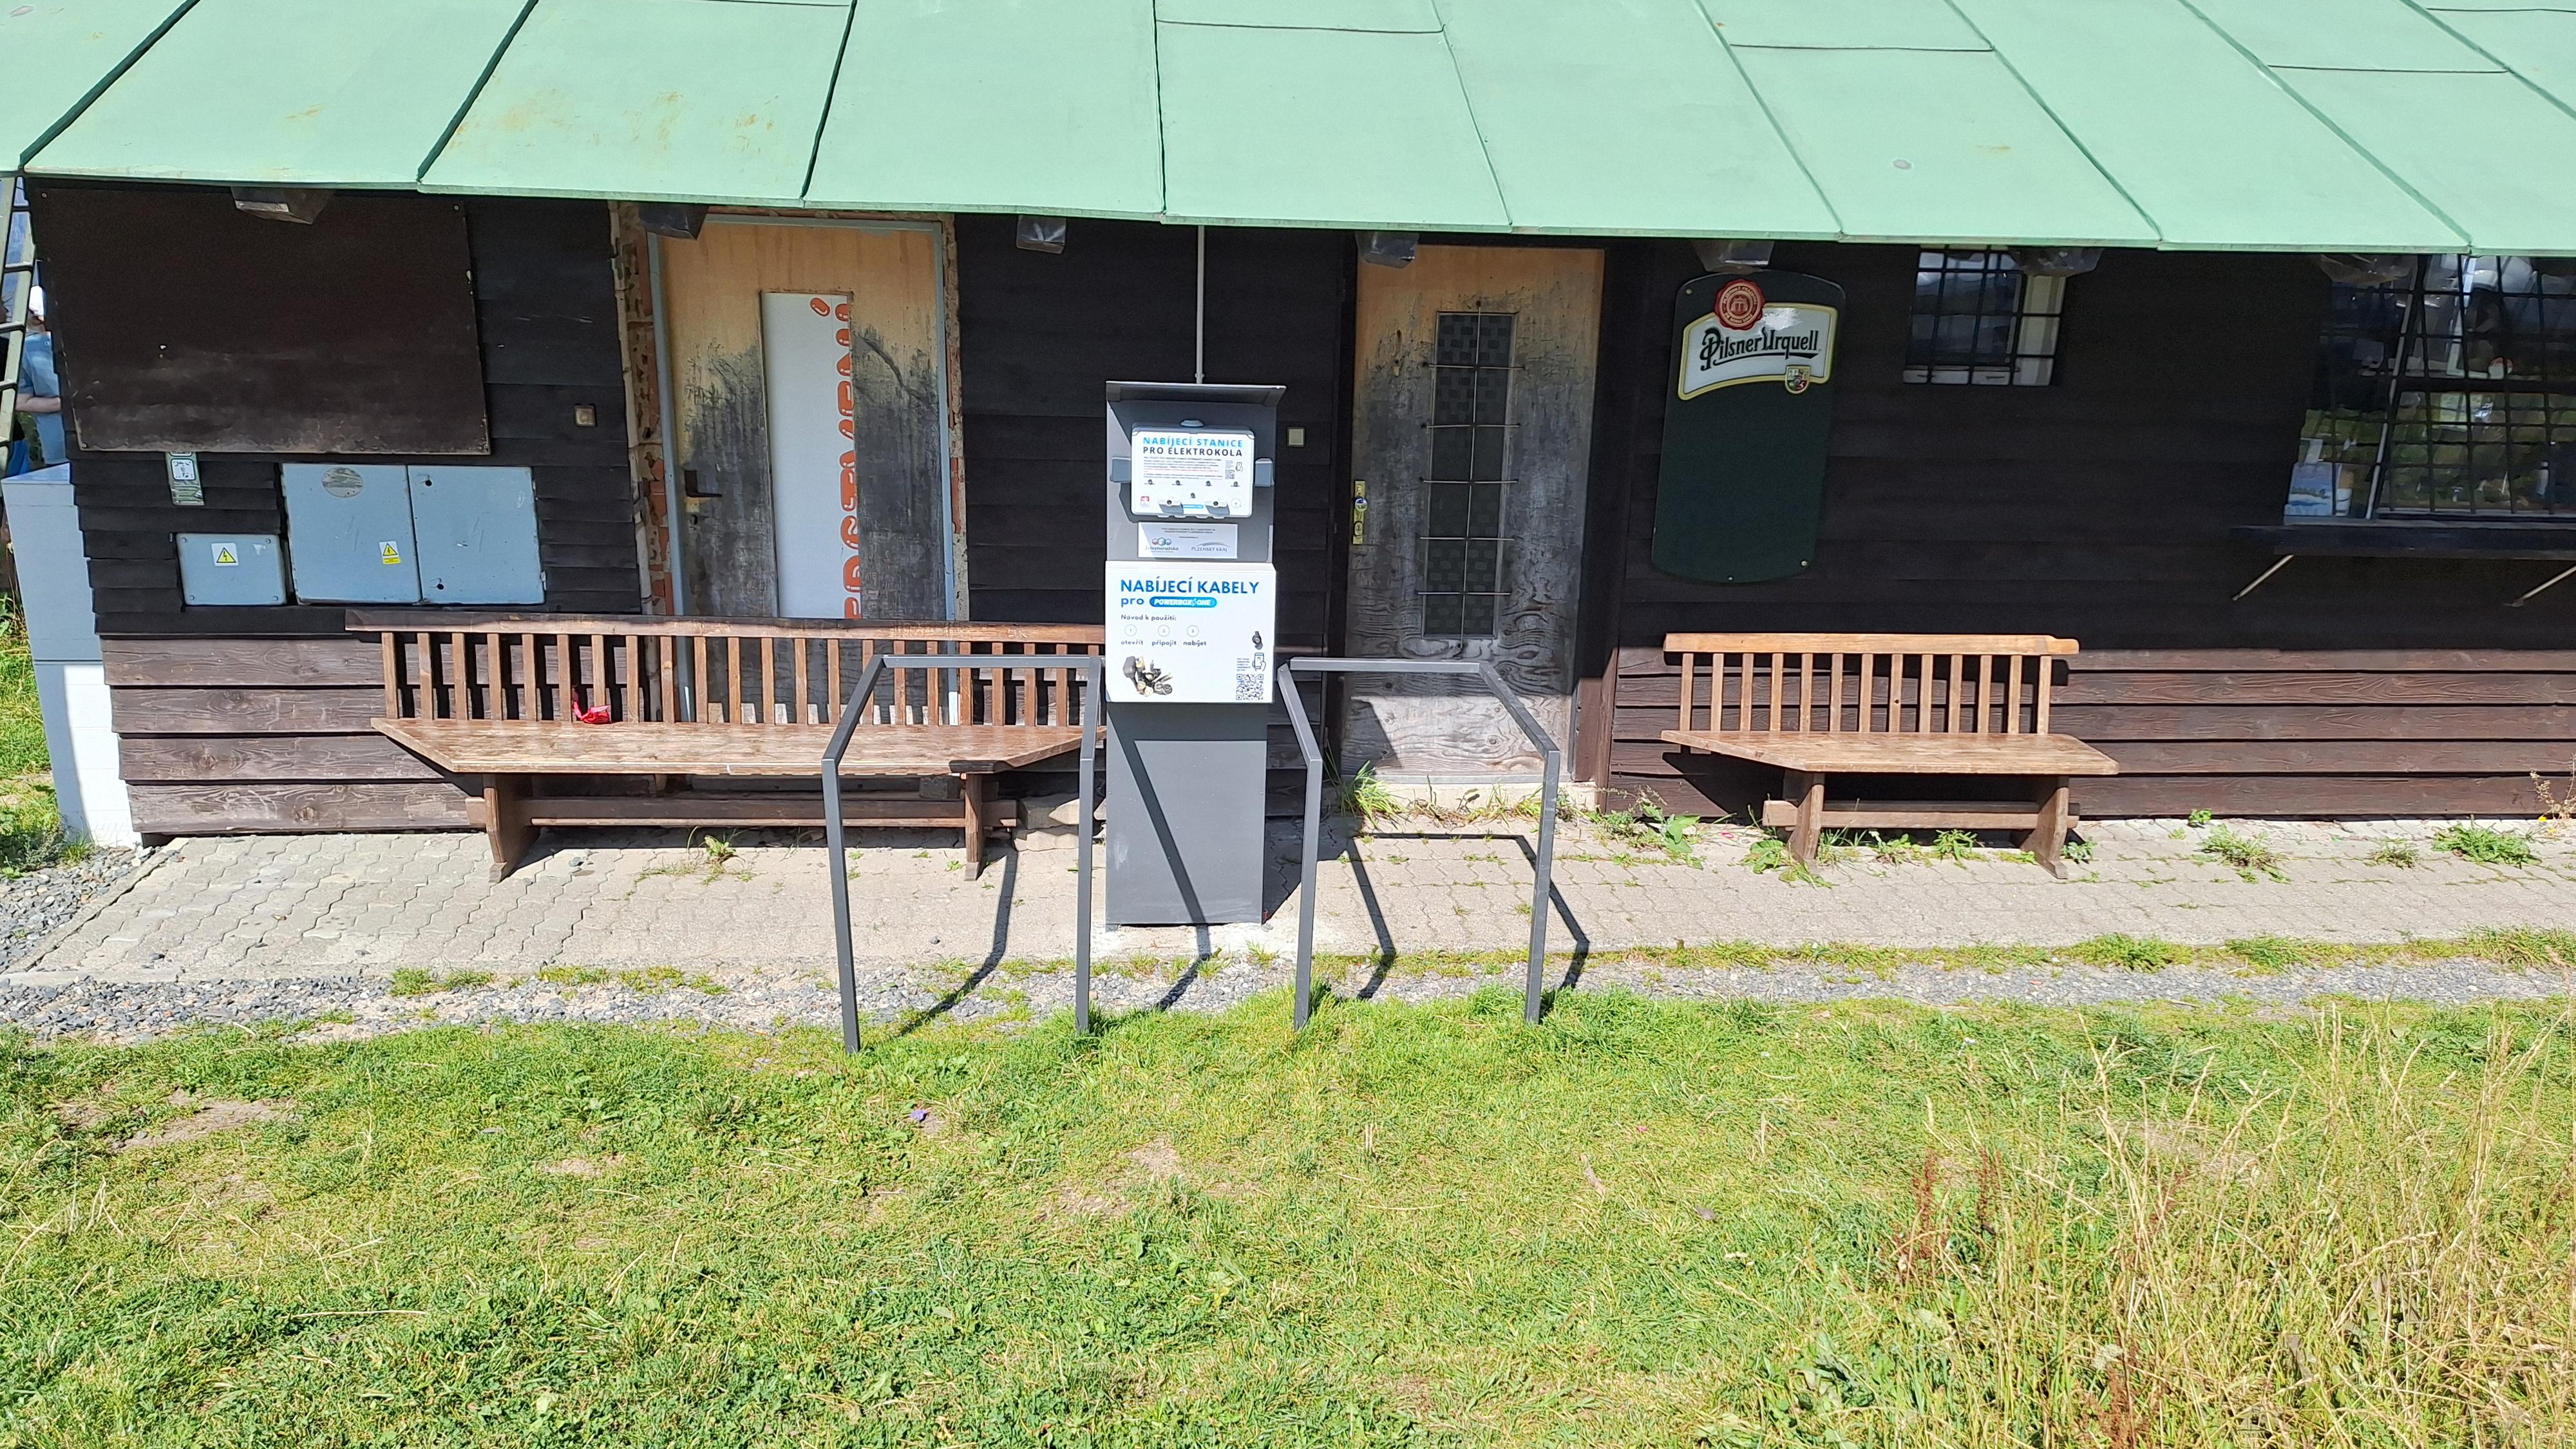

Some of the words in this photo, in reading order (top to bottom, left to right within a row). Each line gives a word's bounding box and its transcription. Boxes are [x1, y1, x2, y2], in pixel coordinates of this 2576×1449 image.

[1700, 327, 1763, 372] Pilsner
[1761, 327, 1819, 361] Urquell
[1143, 436, 1192, 446] NABÍJECÍ
[1197, 439, 1242, 447] STANICE
[1143, 446, 1164, 455] PRO
[1168, 448, 1242, 457] ELEKTROKOLA
[1121, 576, 1193, 593] NABÍJECÍ
[1197, 581, 1260, 594] KABELY
[1121, 598, 1144, 607] pro
